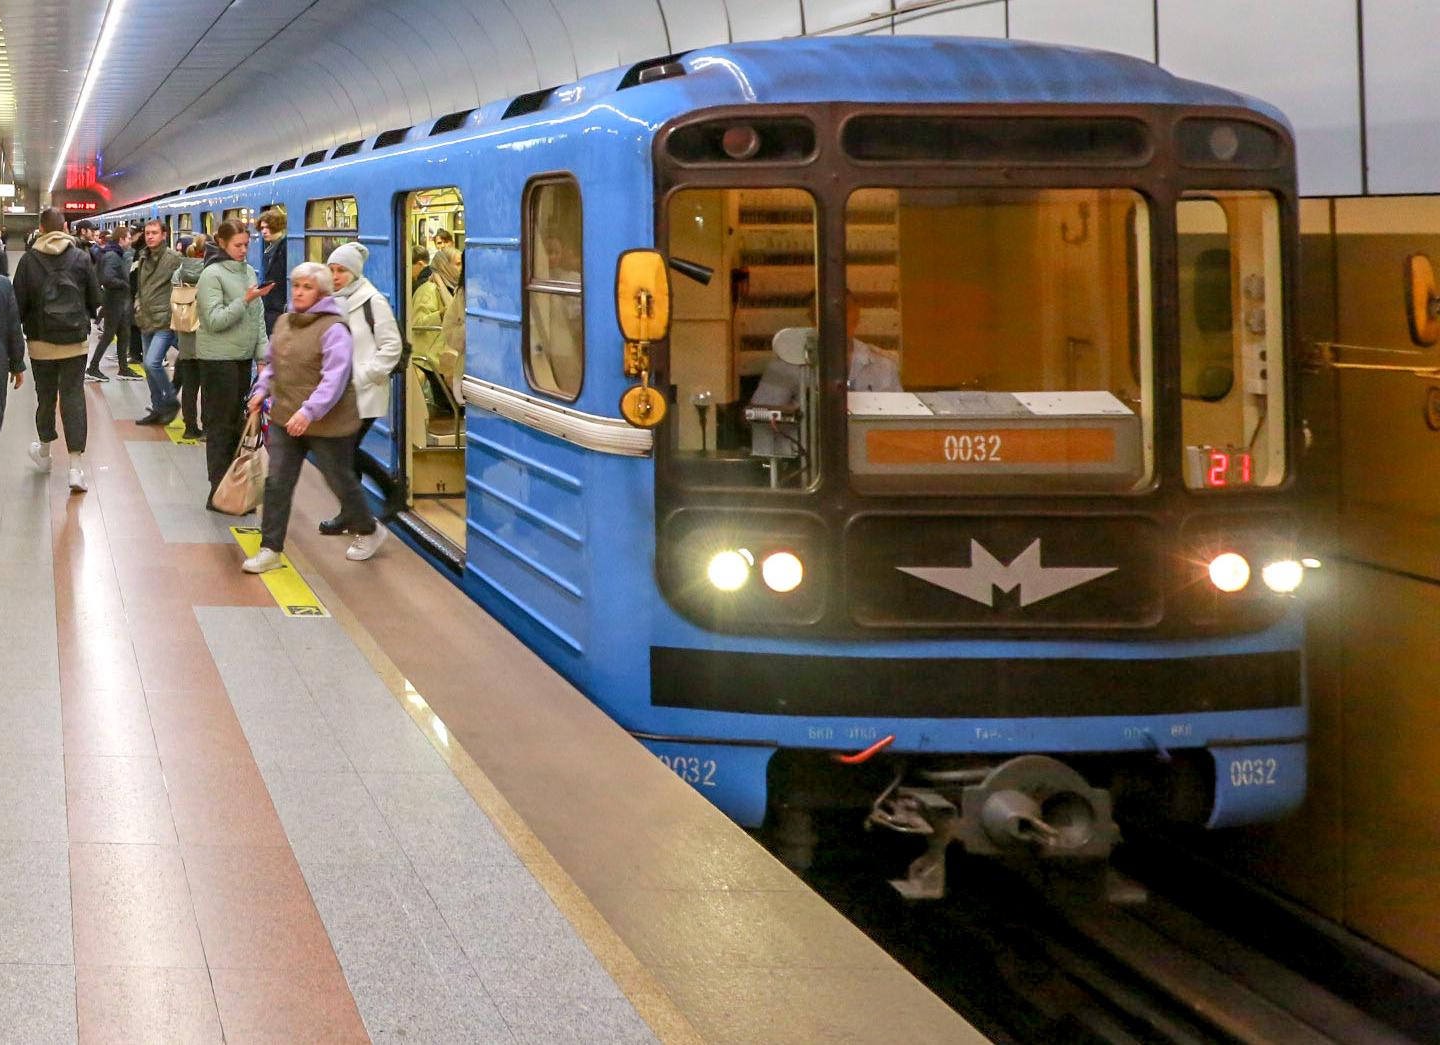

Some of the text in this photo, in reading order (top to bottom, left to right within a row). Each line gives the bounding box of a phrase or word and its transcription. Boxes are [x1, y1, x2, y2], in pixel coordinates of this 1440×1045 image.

[944, 435, 1001, 461] 0032
[1210, 453, 1250, 485] 21
[1231, 758, 1276, 786] 0032
